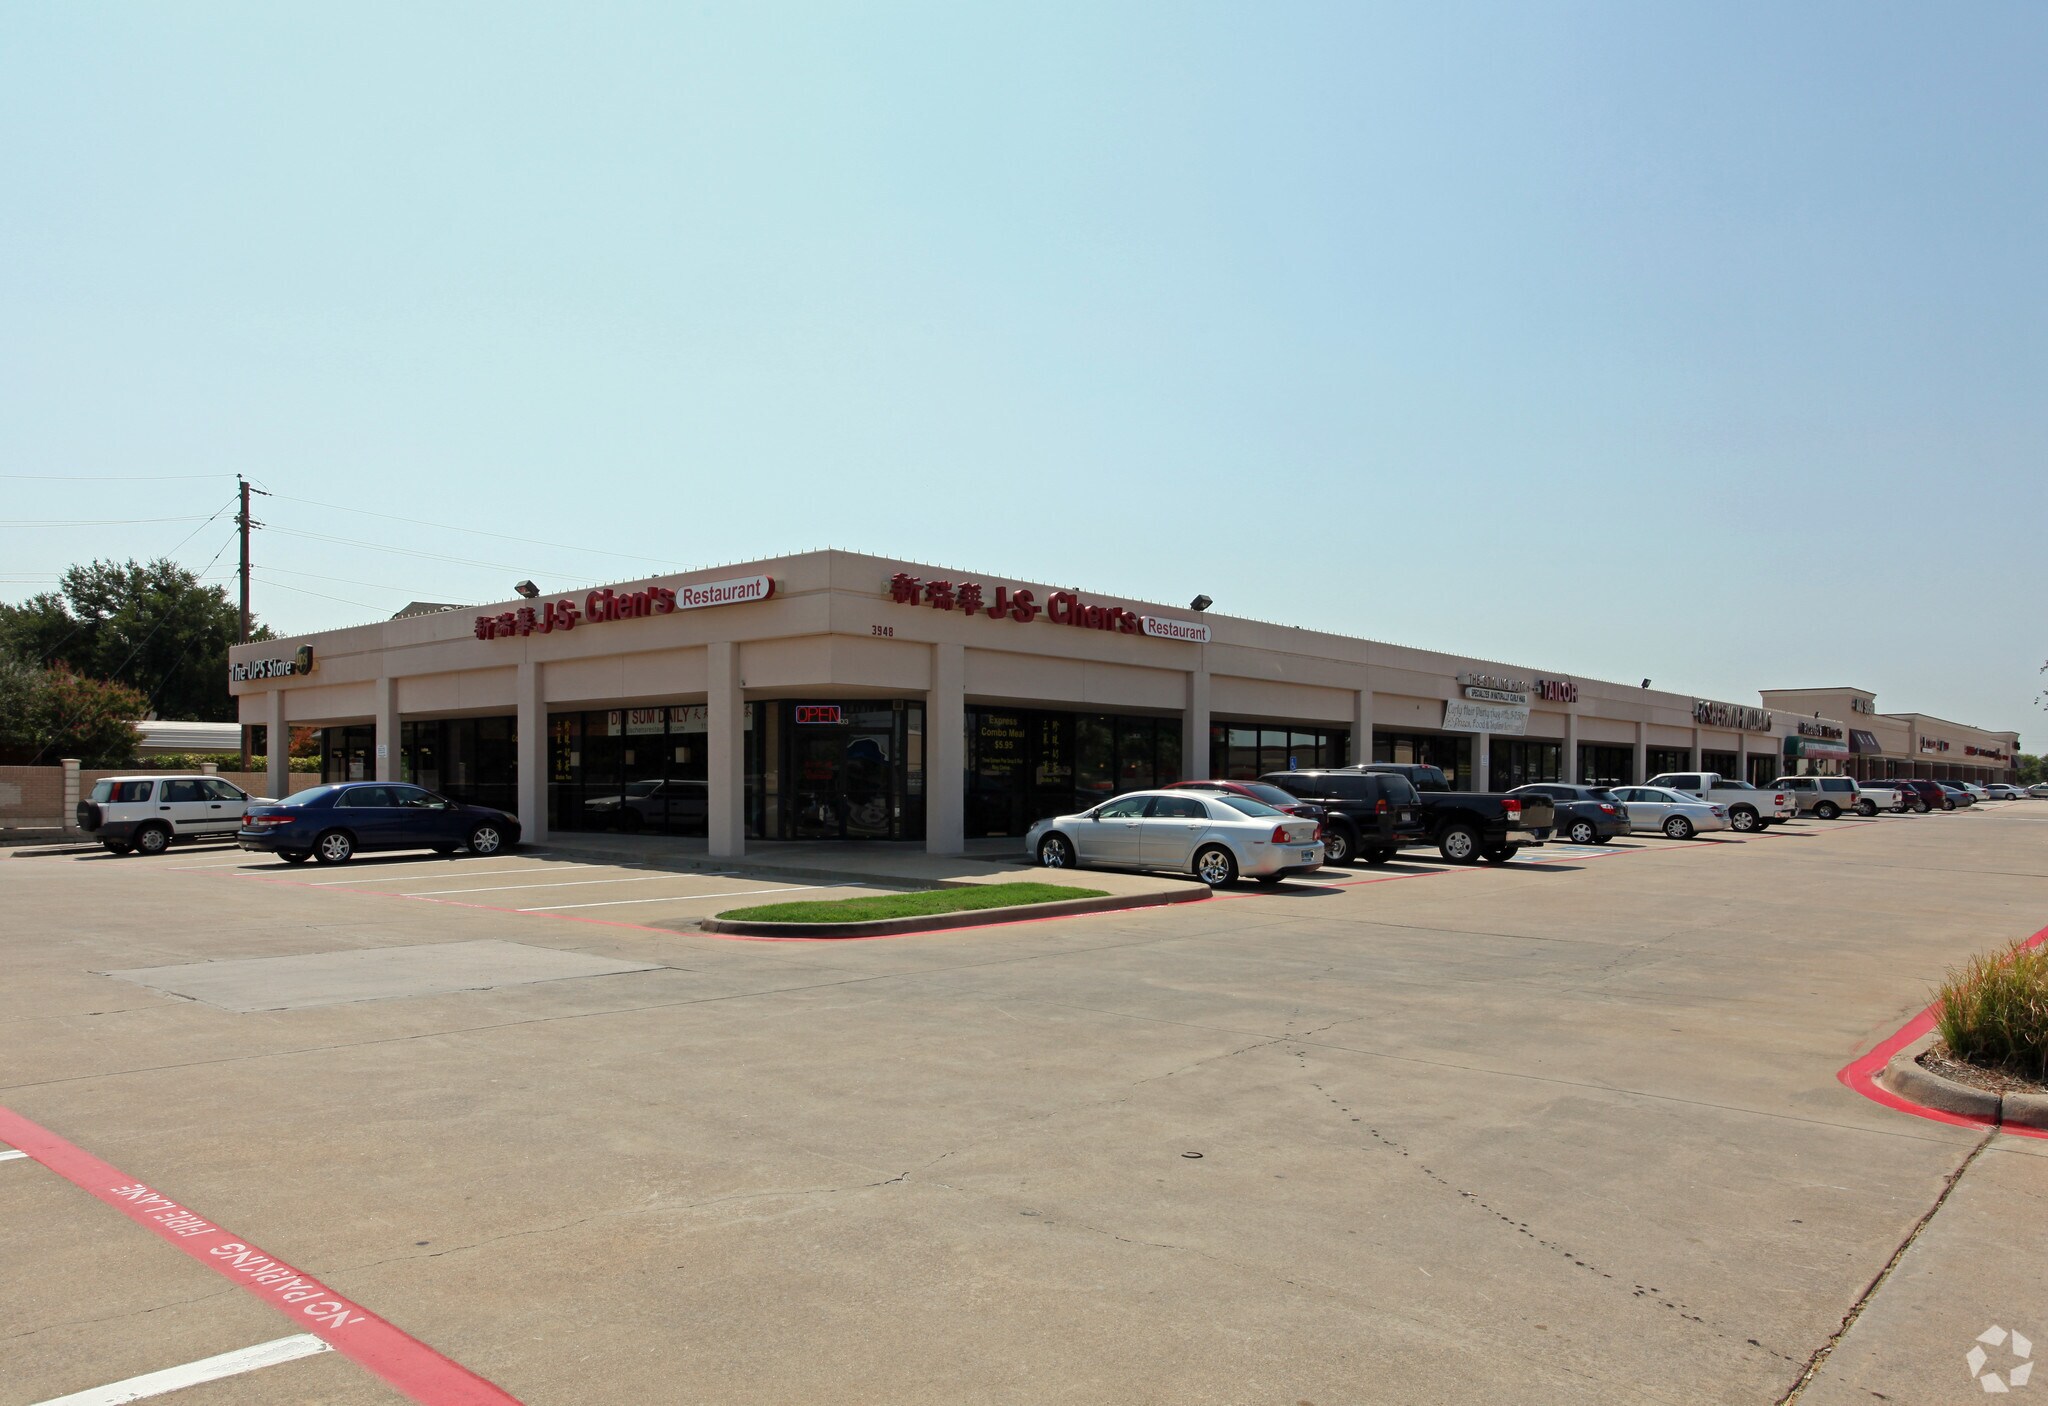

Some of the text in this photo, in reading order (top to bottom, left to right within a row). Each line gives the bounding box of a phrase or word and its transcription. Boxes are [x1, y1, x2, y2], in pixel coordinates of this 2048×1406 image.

[585, 586, 676, 623] Chen's
[683, 579, 761, 607] Restaurant
[1047, 591, 1136, 634] Chen's
[1148, 618, 1206, 641] Restaurant
[871, 625, 894, 637] 3948
[230, 659, 292, 681] The UPS Store
[1542, 679, 1578, 703] TAILOR
[611, 711, 629, 725] DI
[632, 709, 655, 724] SUM
[797, 706, 840, 723] OPEN
[988, 714, 1018, 726] Express
[981, 727, 1025, 738] Combo Meal
[994, 740, 1014, 749] $5.95
[110, 1183, 365, 1329] NO PARKING FIRE LANE
